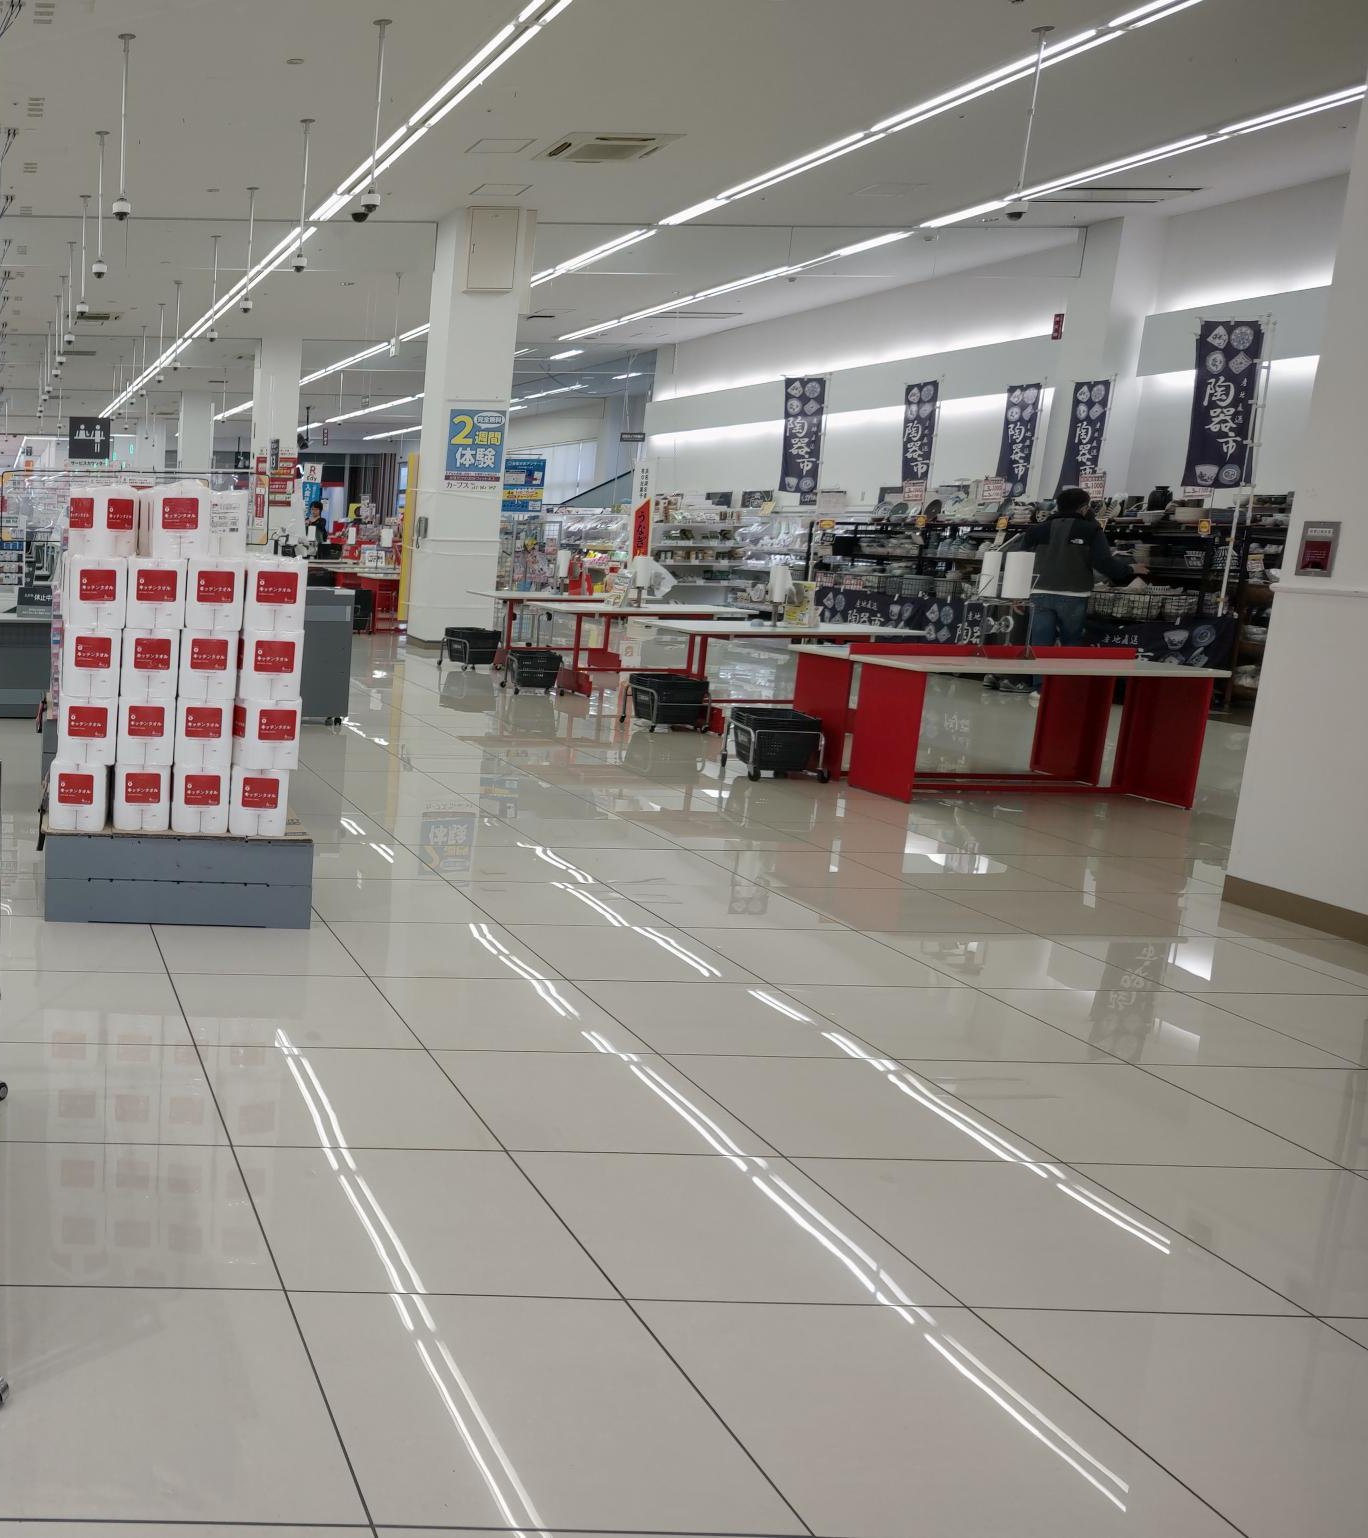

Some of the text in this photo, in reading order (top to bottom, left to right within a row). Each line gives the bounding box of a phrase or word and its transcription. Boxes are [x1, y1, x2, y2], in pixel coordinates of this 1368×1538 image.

[785, 416, 816, 475] 陶器市
[1203, 376, 1242, 460] 陶器市
[456, 447, 496, 468] 体験
[903, 420, 930, 478] 陶器市
[1007, 421, 1030, 480] 陶器市
[637, 512, 646, 548] うなぎ
